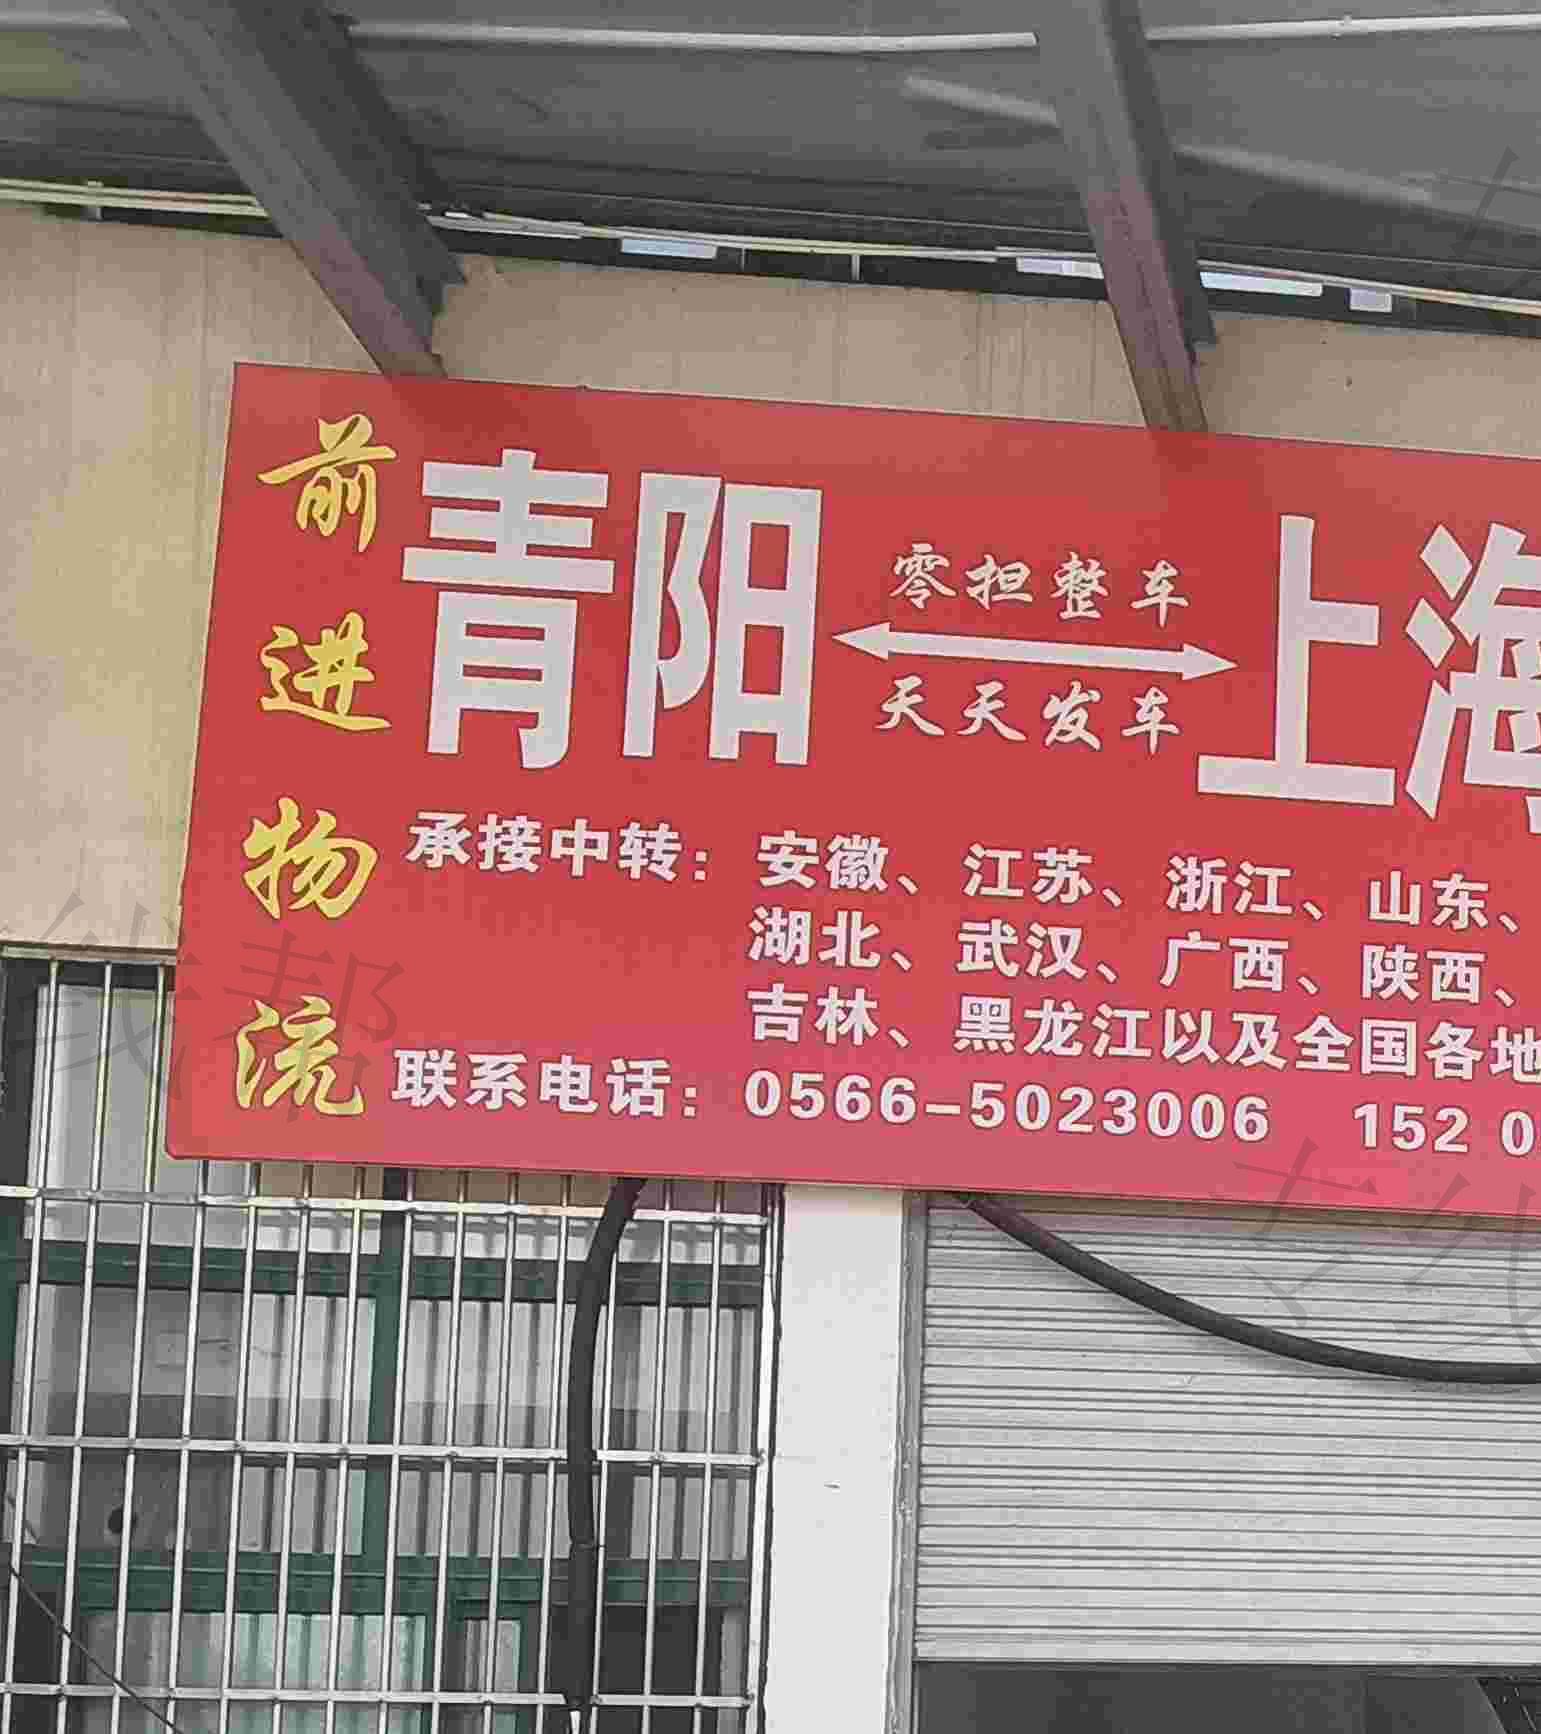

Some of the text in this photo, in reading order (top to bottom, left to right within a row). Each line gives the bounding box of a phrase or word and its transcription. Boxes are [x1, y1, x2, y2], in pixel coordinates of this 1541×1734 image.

[401, 448, 823, 770] 青阳
[888, 542, 1190, 627] 零担整车
[874, 674, 1183, 756] 天天发车
[234, 413, 398, 1118] 前进物流
[1352, 1101, 1470, 1155] 152
